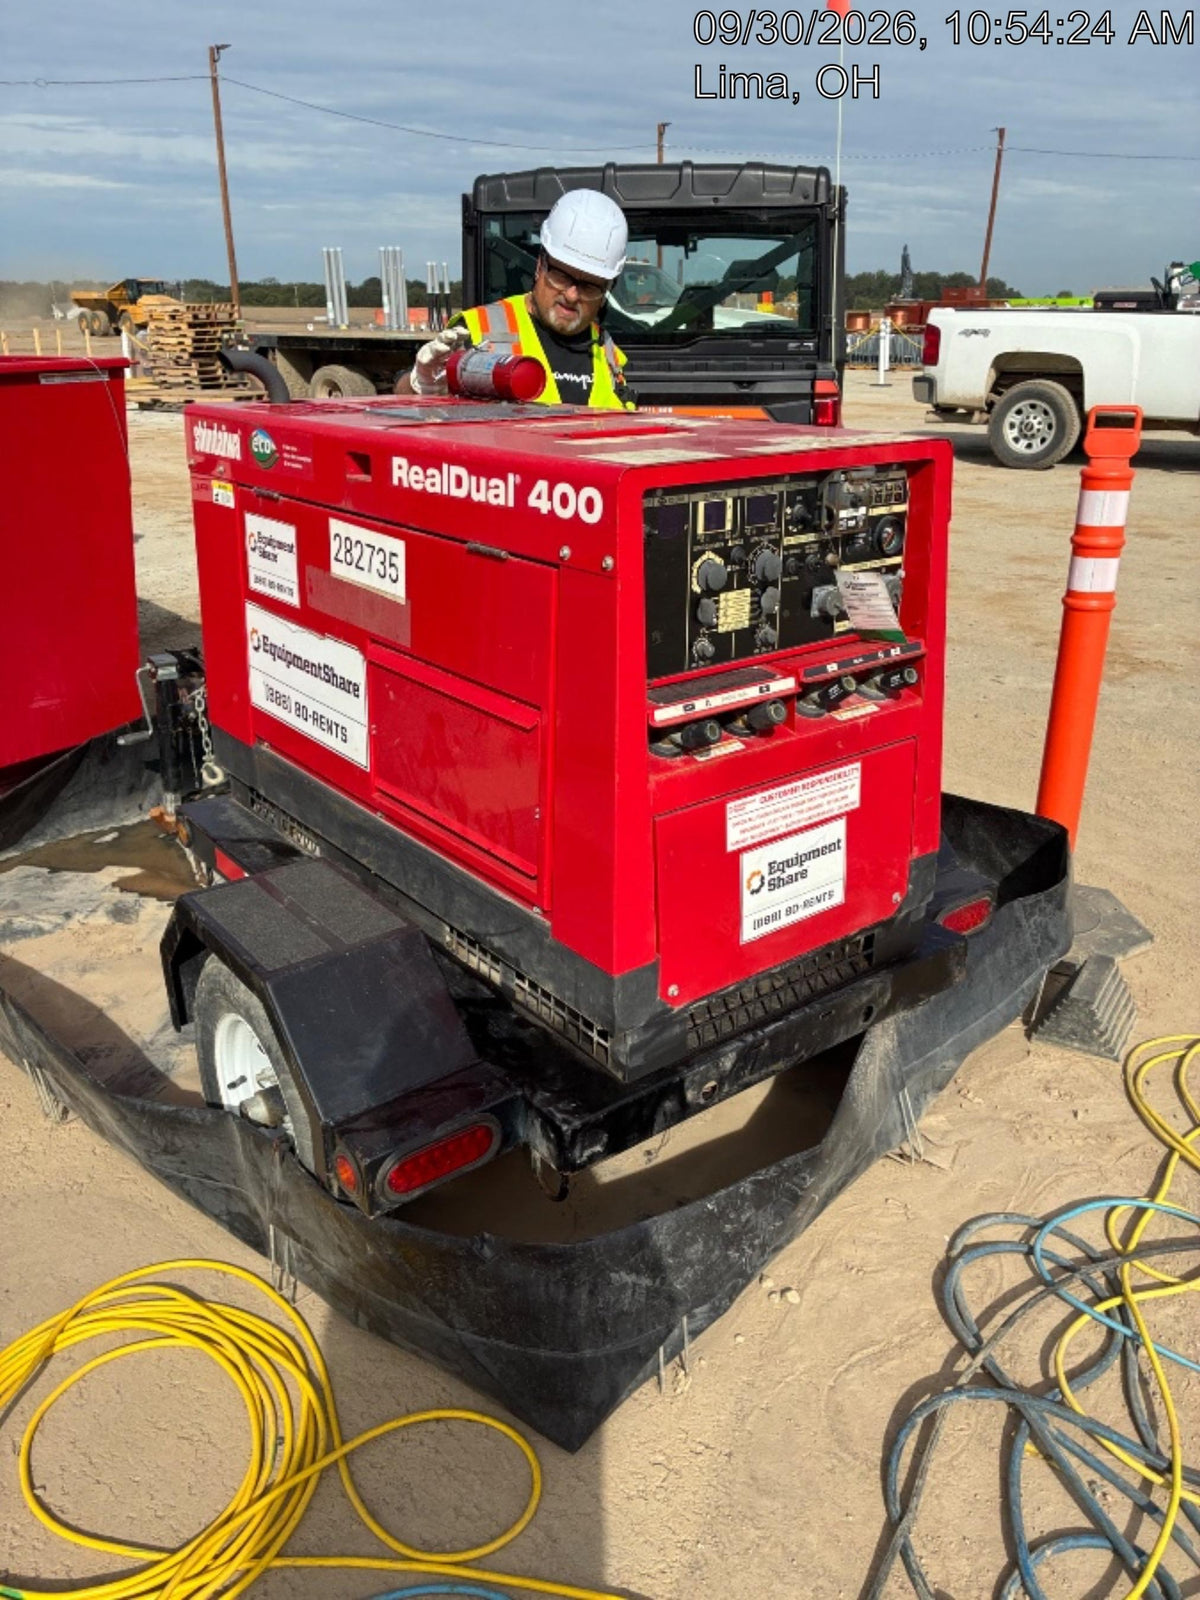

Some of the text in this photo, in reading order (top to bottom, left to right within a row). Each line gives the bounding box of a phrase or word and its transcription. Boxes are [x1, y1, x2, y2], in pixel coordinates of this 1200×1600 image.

[527, 479, 603, 524] 400
[333, 532, 400, 584] 282735
[262, 634, 361, 698] EquipmentShare
[295, 701, 348, 744] 80-RENTS
[768, 838, 842, 875] Equipment
[768, 869, 808, 892] Share
